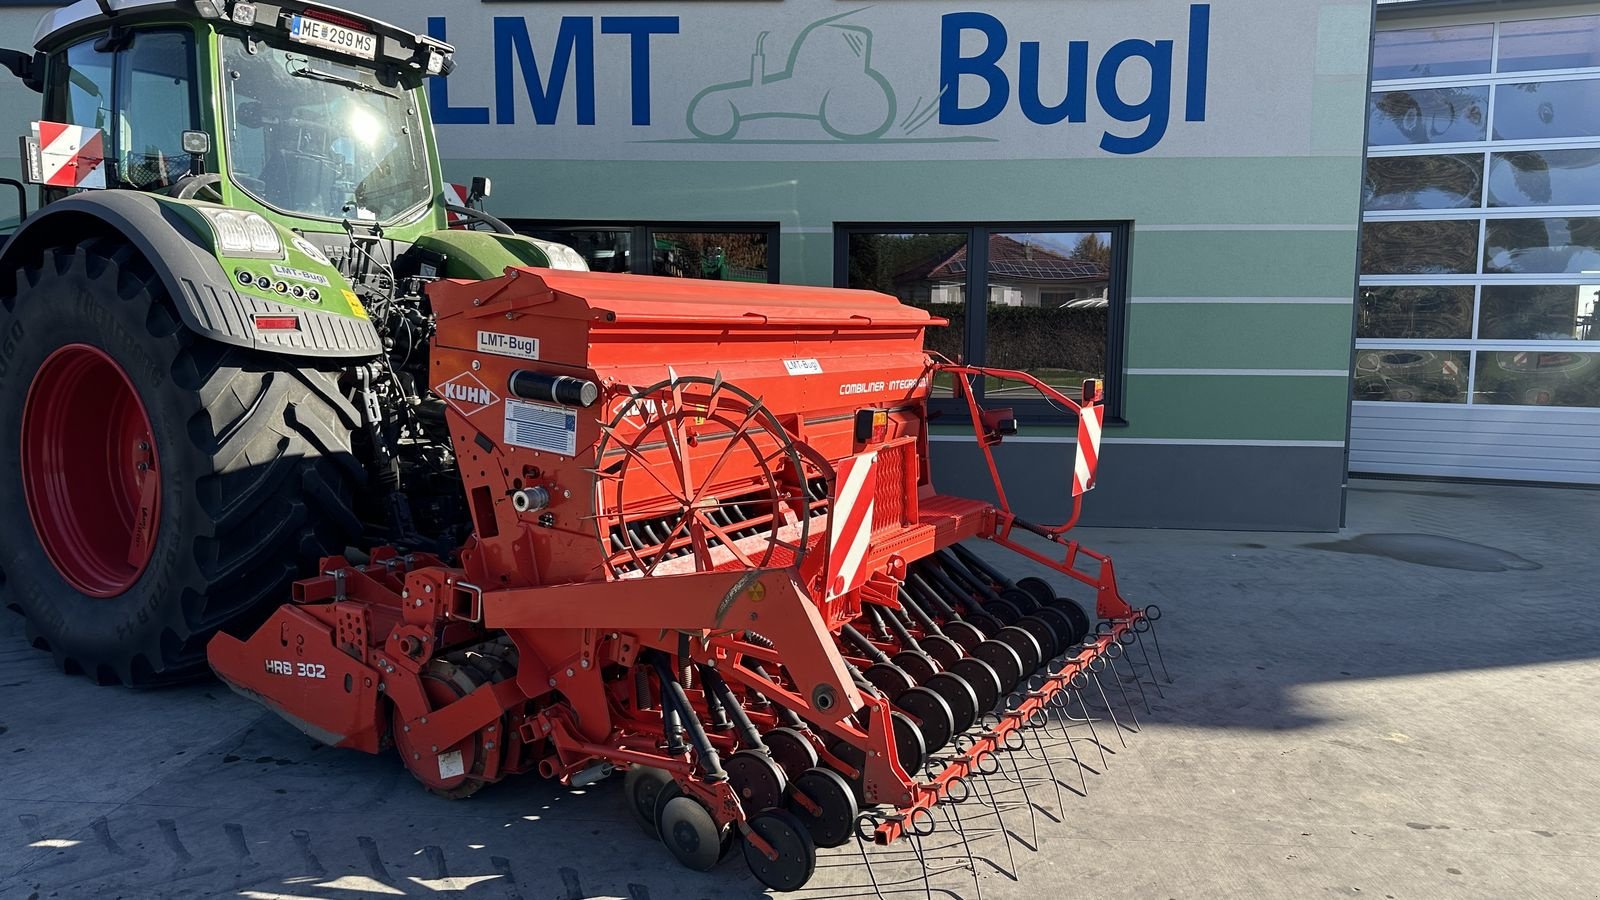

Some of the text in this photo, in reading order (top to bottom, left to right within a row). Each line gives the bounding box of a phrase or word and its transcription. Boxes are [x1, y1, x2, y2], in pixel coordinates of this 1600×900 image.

[302, 20, 372, 51] ME 299 MS
[427, 3, 1210, 155] LMT Bugl
[273, 265, 328, 284] LMT-Bugl
[480, 332, 536, 354] LMT-Bugl
[785, 360, 818, 370] LMT-Bugl
[445, 383, 491, 405] KUHN
[839, 381, 884, 395] COMBILINER
[265, 659, 326, 679] HRB 302
